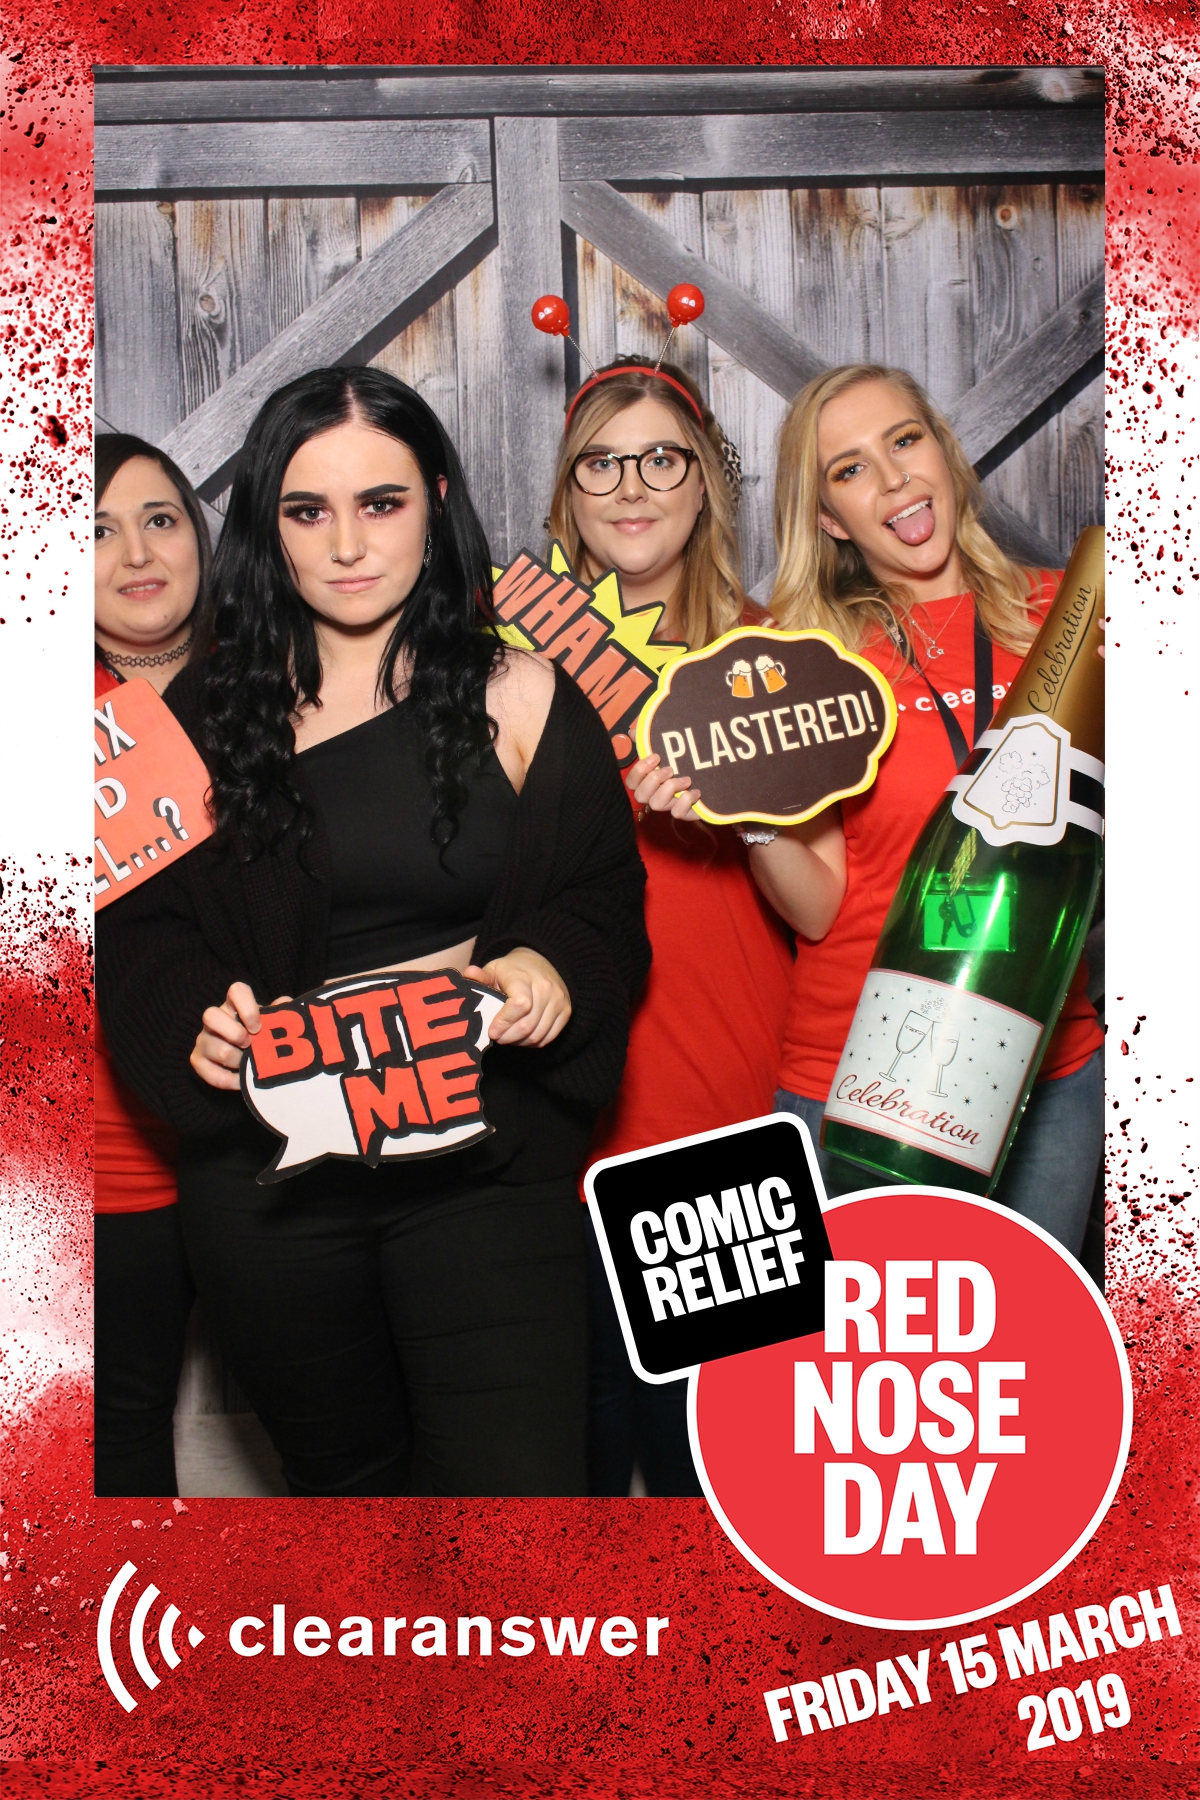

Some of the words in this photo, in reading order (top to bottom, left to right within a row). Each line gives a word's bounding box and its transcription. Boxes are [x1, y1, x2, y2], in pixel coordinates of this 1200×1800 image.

[492, 553, 653, 759] WHAM
[1027, 583, 1092, 714] Celebration
[661, 690, 879, 775] PLASTERED!
[250, 975, 469, 1080] BITE
[344, 1051, 481, 1156] ME
[835, 1073, 982, 1147] Celebration
